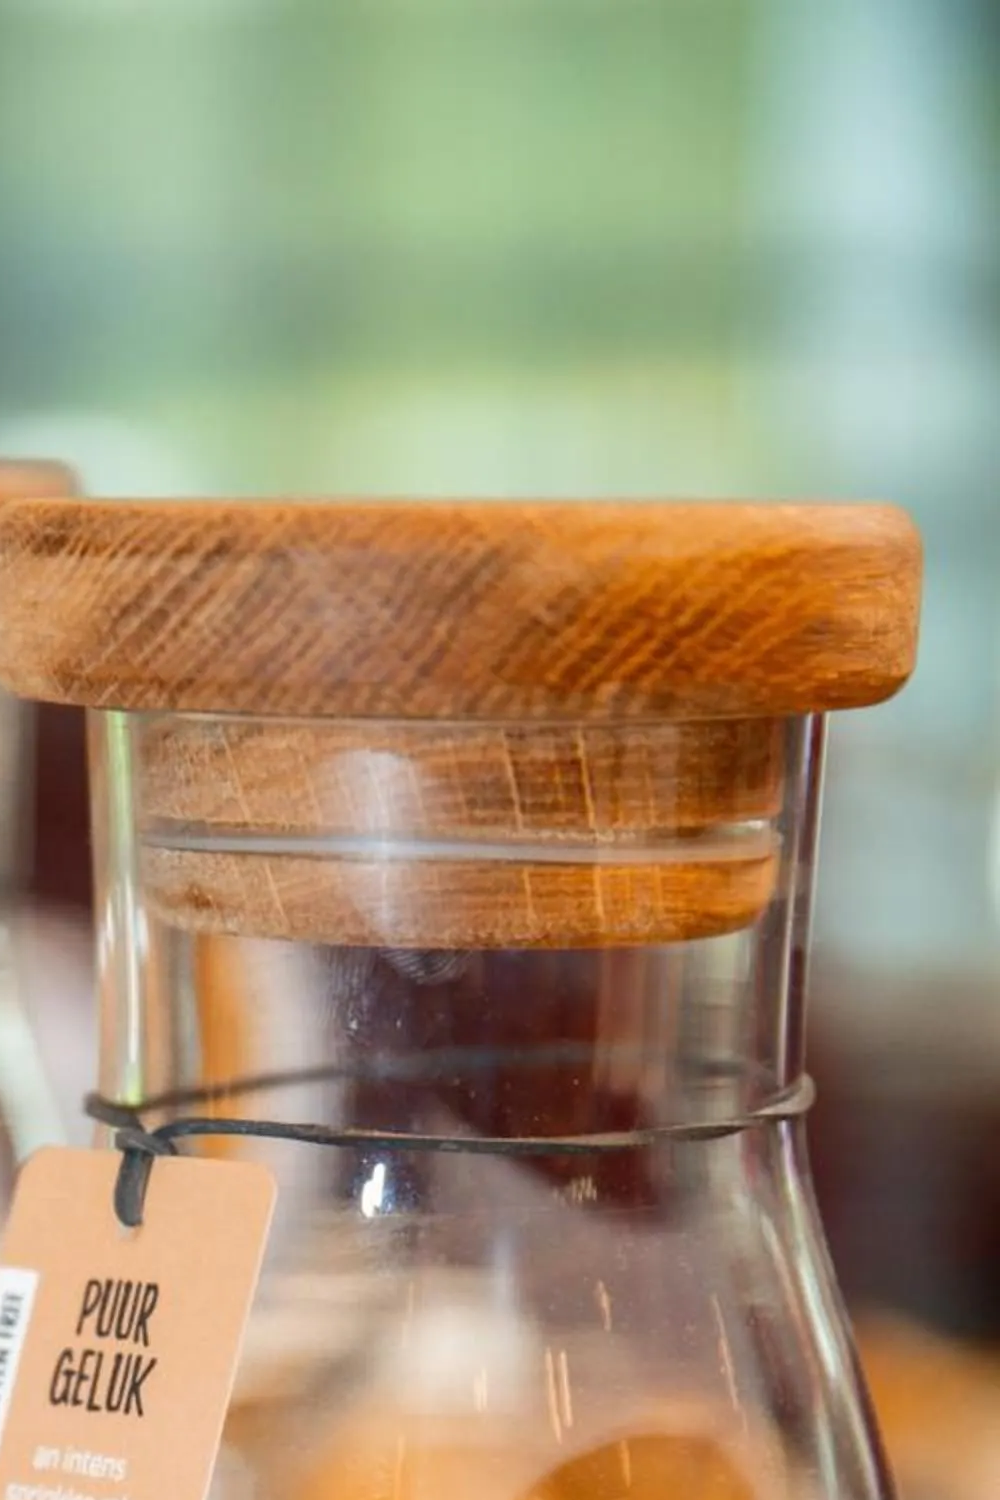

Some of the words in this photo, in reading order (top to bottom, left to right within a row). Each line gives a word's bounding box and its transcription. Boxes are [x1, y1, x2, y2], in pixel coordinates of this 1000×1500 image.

[76, 1279, 159, 1347] PUUR
[49, 1348, 157, 1417] GELUK
[63, 1448, 127, 1482] intens
